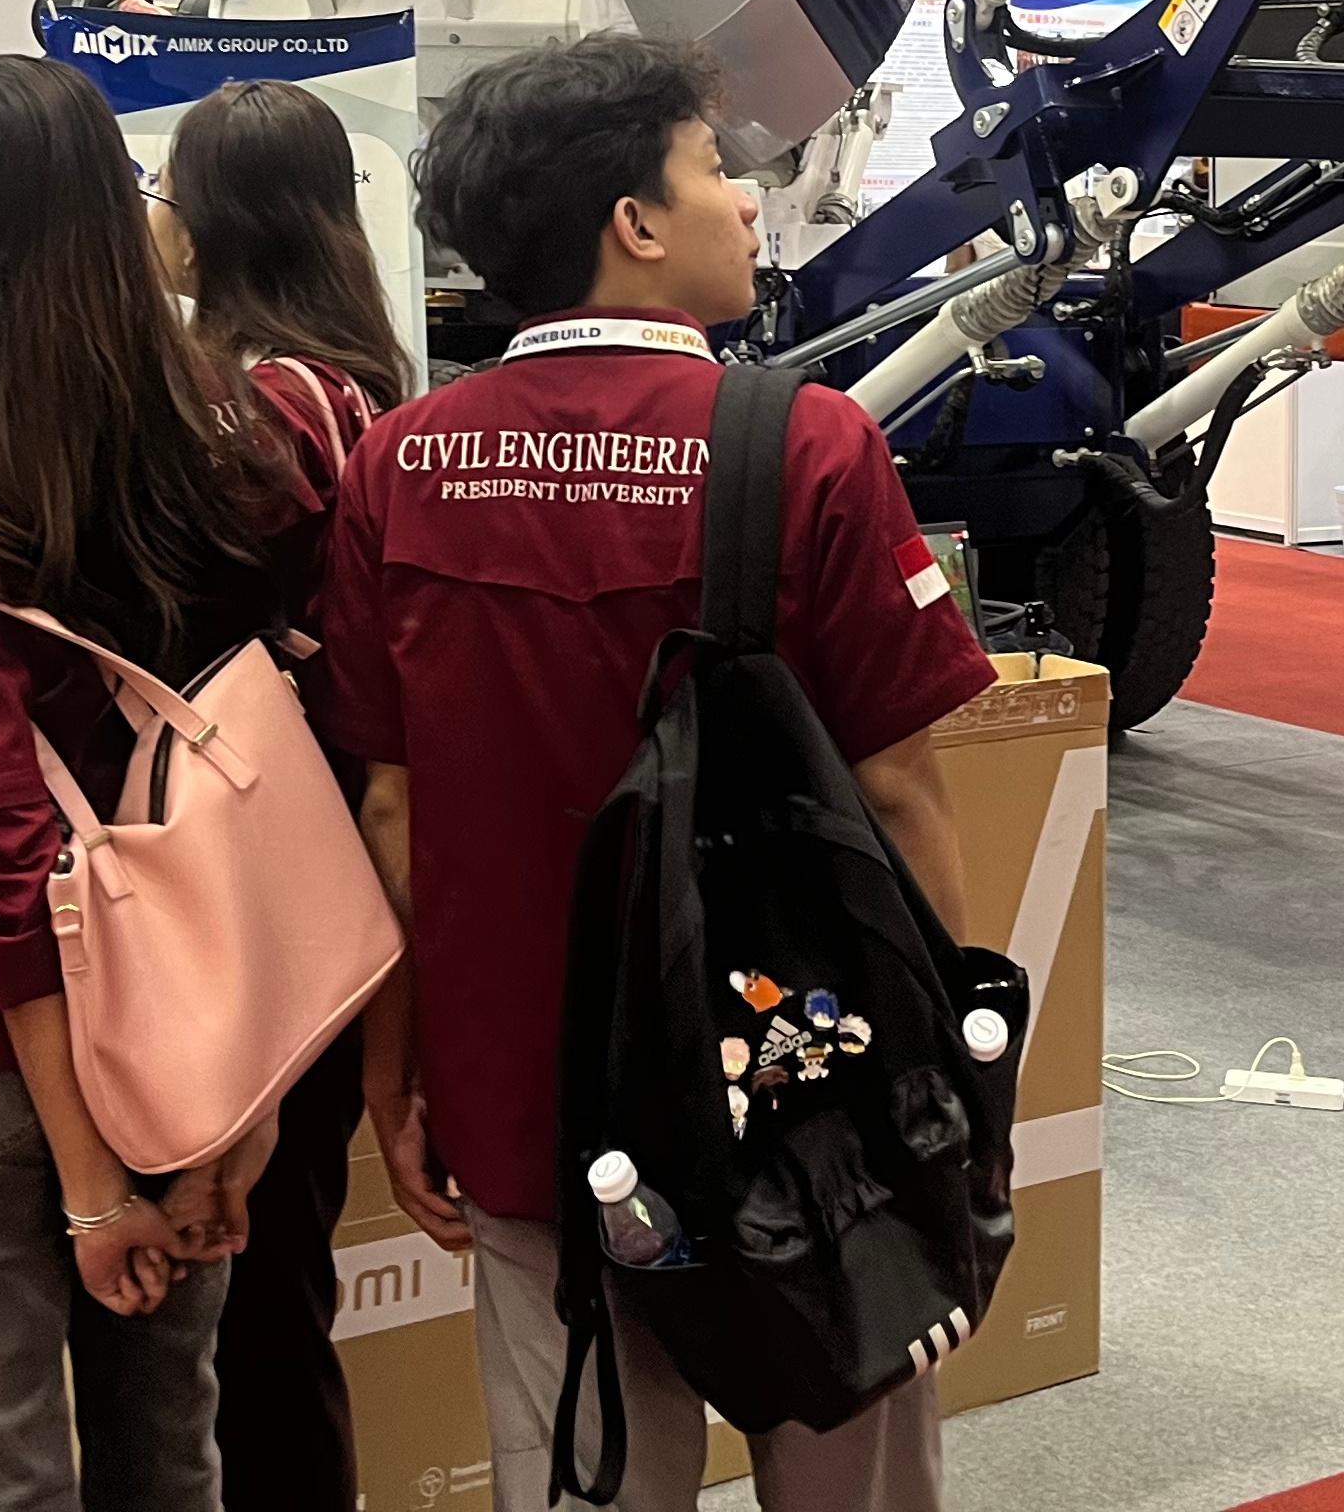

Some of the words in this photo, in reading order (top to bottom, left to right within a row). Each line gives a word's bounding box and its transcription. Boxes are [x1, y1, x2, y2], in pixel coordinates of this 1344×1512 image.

[72, 24, 158, 64] AIMIX
[166, 38, 214, 53] AIMIX
[217, 37, 279, 53] GROUP
[641, 328, 710, 352] ONEWA
[397, 431, 490, 471] CIVIL
[495, 430, 710, 476] ENGINEERIN
[441, 478, 560, 501] PRESIDENT
[565, 482, 694, 506] UNIVERSITY
[758, 1031, 813, 1066] adidas
